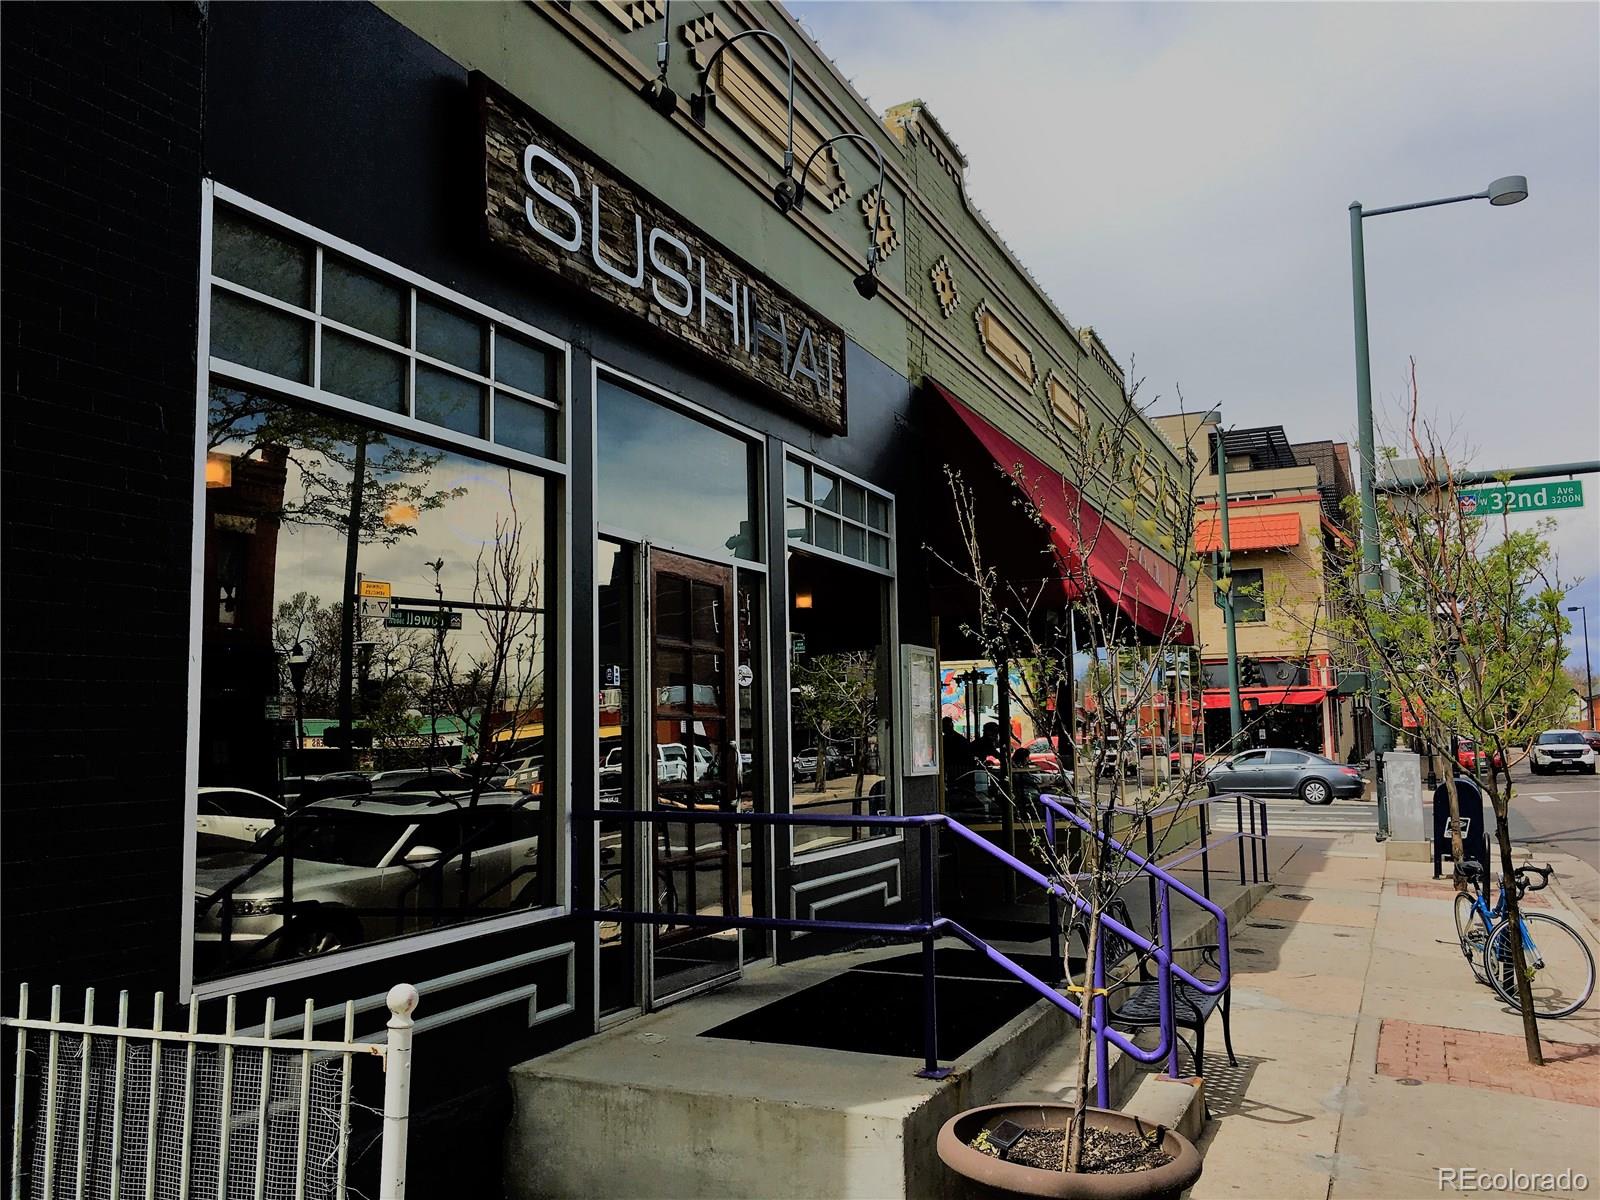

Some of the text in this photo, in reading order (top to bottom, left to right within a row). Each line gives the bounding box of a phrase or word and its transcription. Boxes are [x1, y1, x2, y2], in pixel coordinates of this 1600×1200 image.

[1556, 486, 1574, 495] Ave
[1490, 487, 1548, 510] 32nd
[1551, 494, 1581, 504] 3200N
